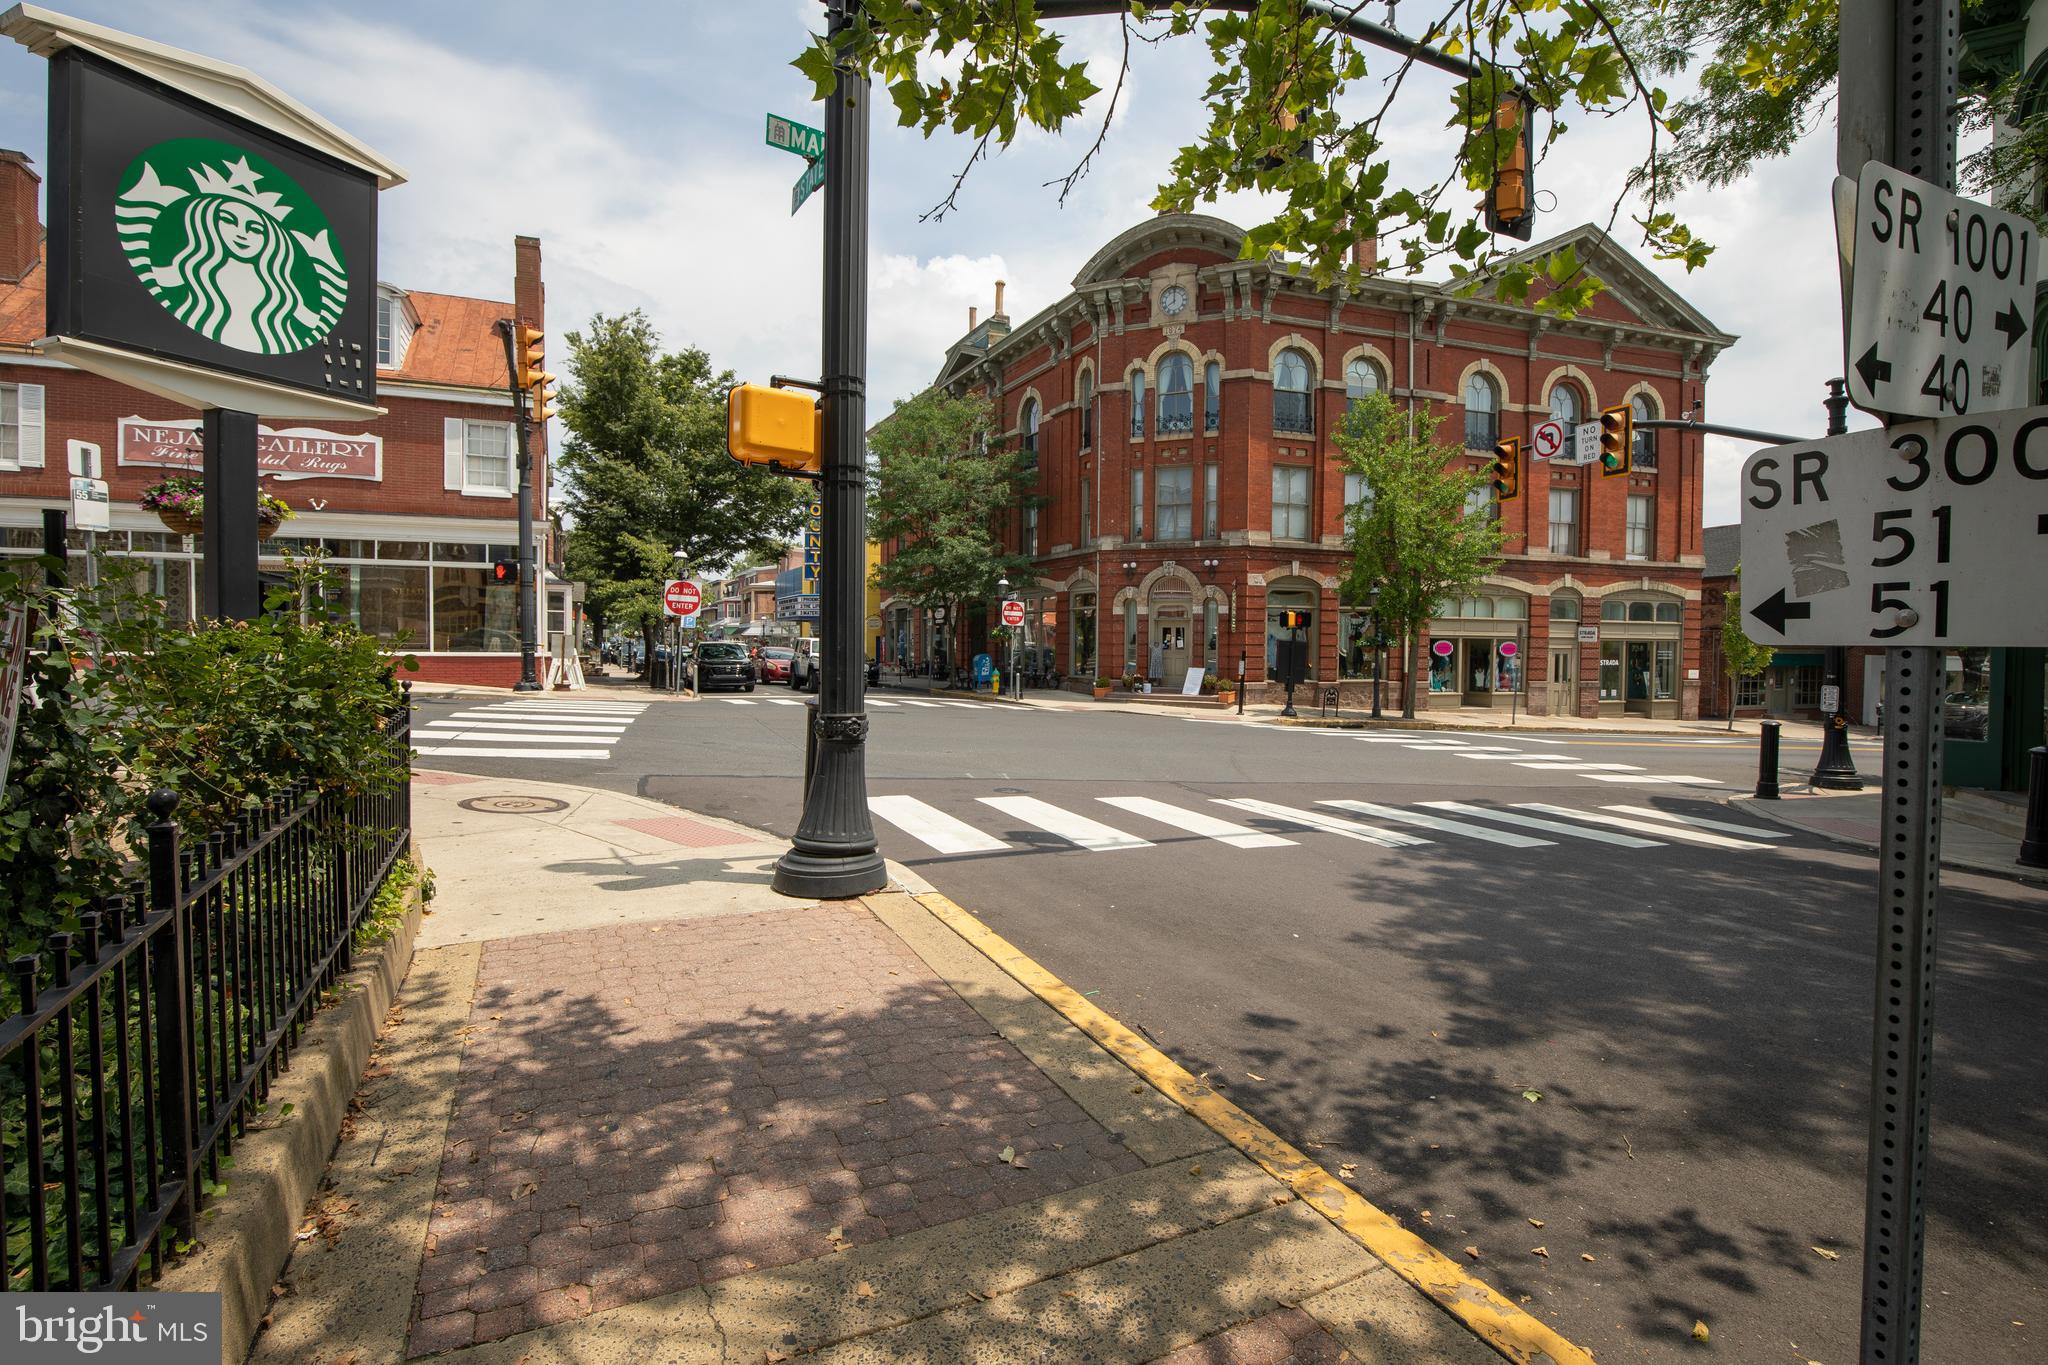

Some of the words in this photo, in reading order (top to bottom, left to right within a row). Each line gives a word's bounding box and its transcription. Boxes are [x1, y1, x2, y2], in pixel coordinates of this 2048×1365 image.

[791, 127, 825, 156] MAI
[800, 152, 824, 200] STATE
[1872, 179, 1923, 254] SR
[1946, 208, 2029, 286] 1001
[1922, 279, 1973, 344] 40
[1920, 354, 1970, 416] 40
[132, 427, 203, 447] NEJA
[1581, 435, 1598, 445] TURN
[1582, 425, 1597, 435] NO
[1584, 444, 1595, 452] ON
[151, 445, 200, 459] Fine
[300, 457, 347, 473] Rugs
[1748, 451, 1829, 509] SR
[76, 490, 89, 500] 55
[810, 495, 821, 577] OUNTY
[1871, 505, 1951, 567] 51
[1870, 580, 1950, 638] 51
